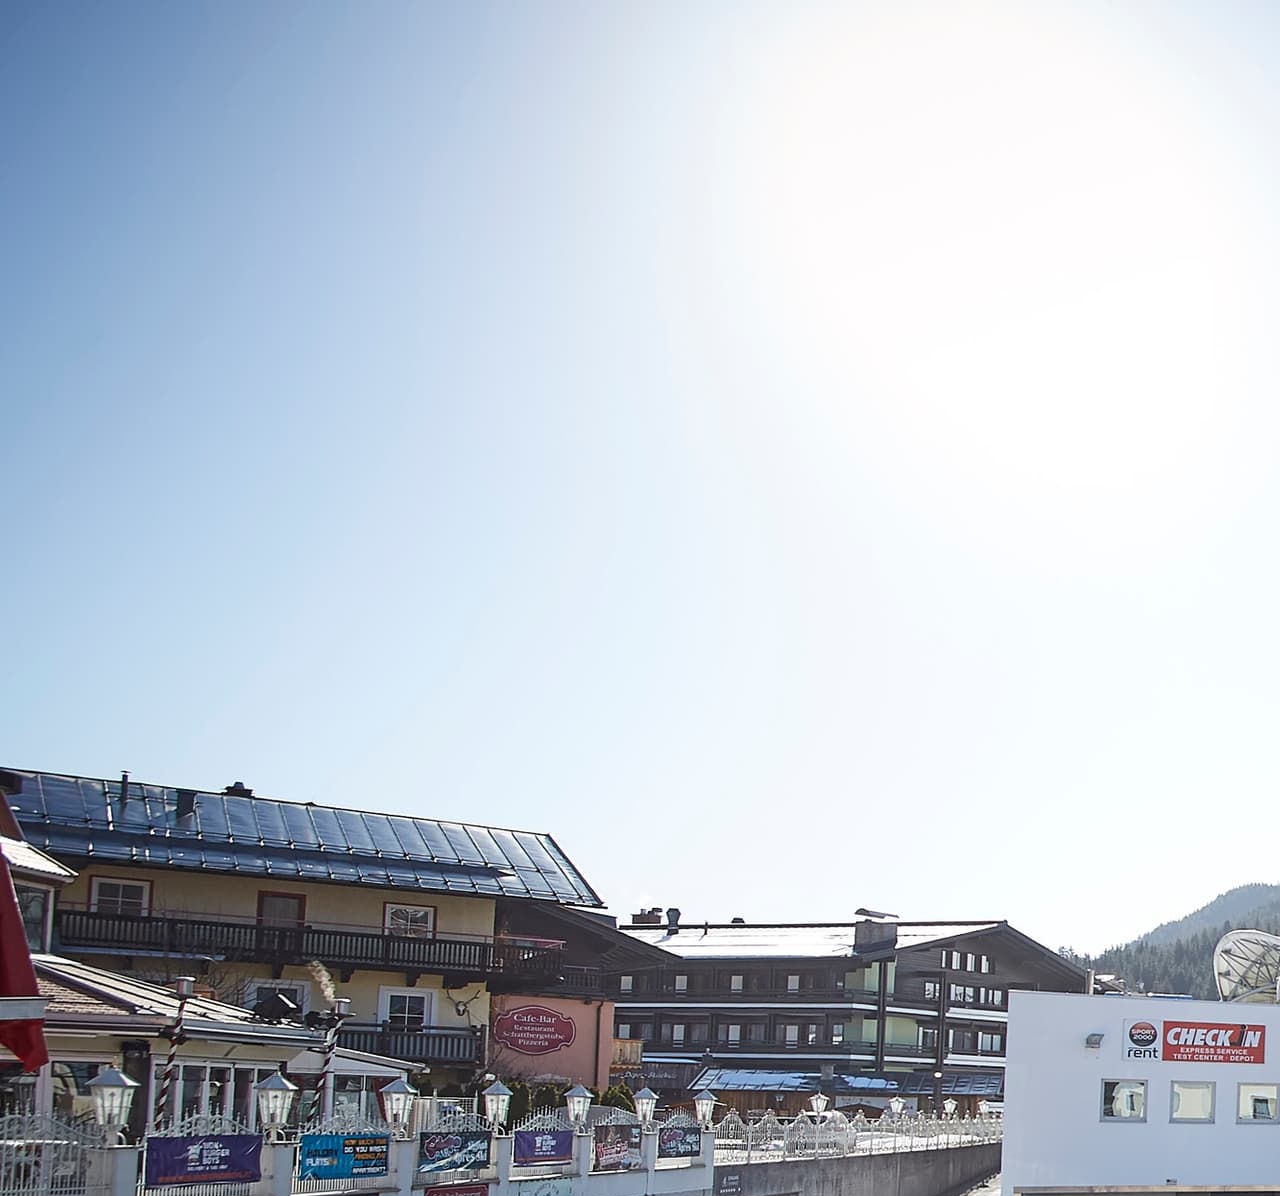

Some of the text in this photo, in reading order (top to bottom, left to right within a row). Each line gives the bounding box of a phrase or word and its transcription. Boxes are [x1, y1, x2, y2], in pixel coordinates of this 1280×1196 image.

[513, 1013, 556, 1024] Cafe-Bar
[514, 1024, 555, 1033] Restaurant
[1166, 1027, 1234, 1047] CHECK
[518, 1038, 550, 1047] Pizzeria
[1127, 1047, 1159, 1059] rent
[1180, 1047, 1248, 1056] EXPRESS SERVICE
[1193, 1054, 1224, 1062] CENTER
